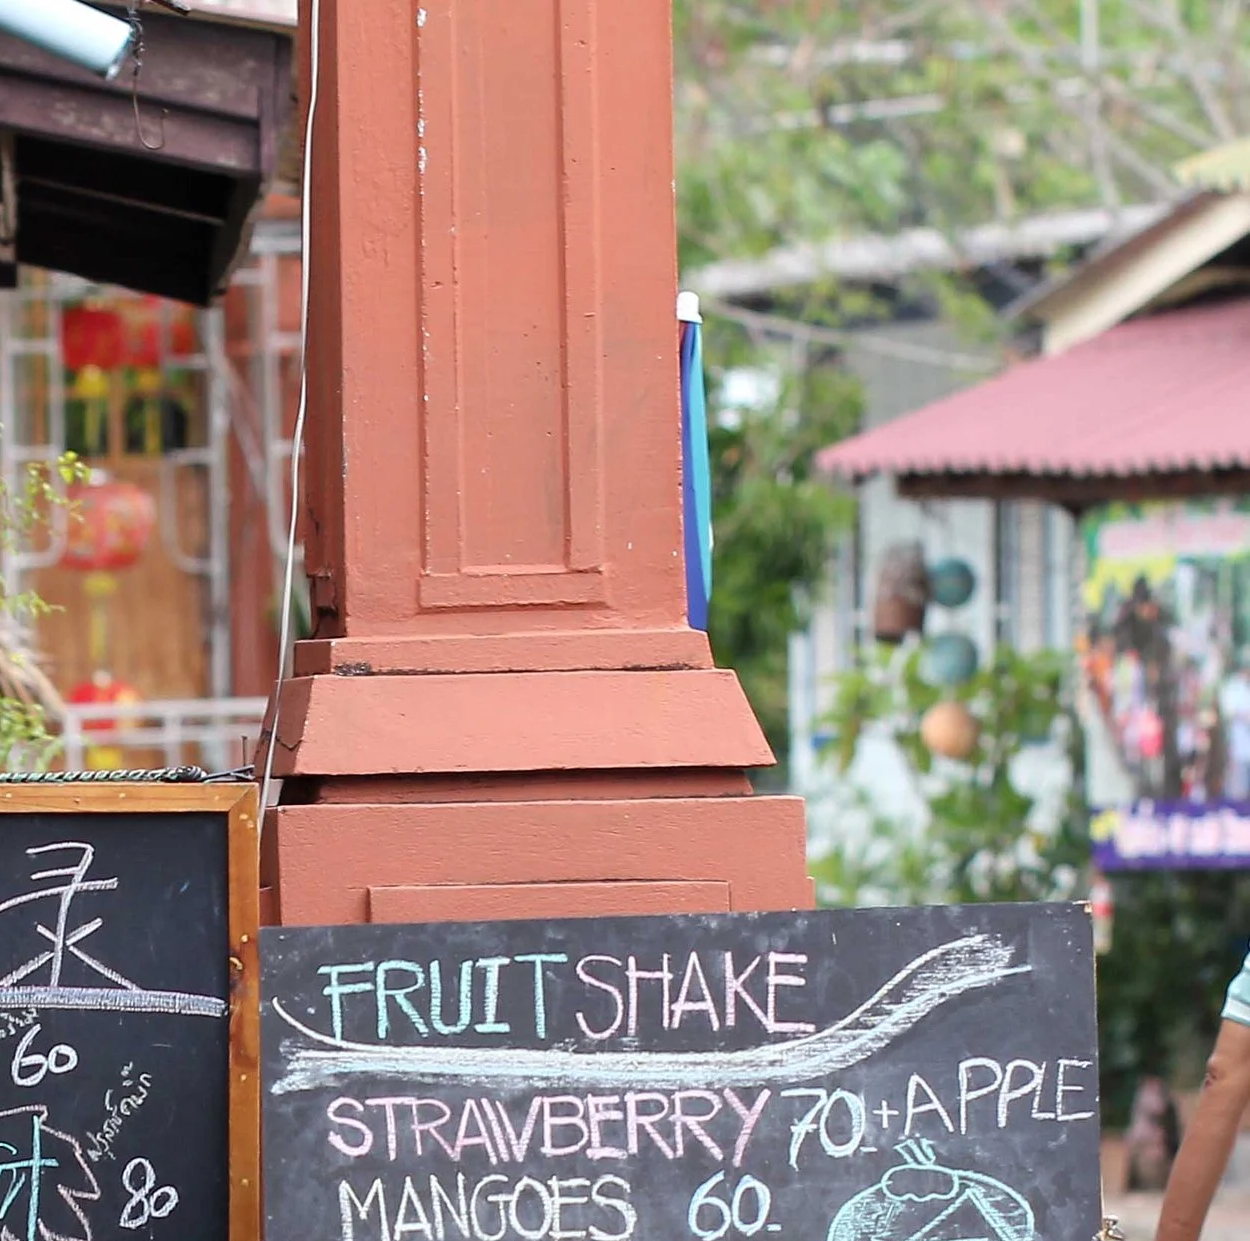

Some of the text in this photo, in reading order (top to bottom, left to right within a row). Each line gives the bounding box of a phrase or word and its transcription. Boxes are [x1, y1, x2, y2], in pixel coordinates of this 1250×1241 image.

[317, 951, 816, 1041] FRUIT SHAKE
[11, 1023, 78, 1086] 60
[327, 1088, 770, 1166] STRAWBERRY
[119, 1157, 179, 1230] 80
